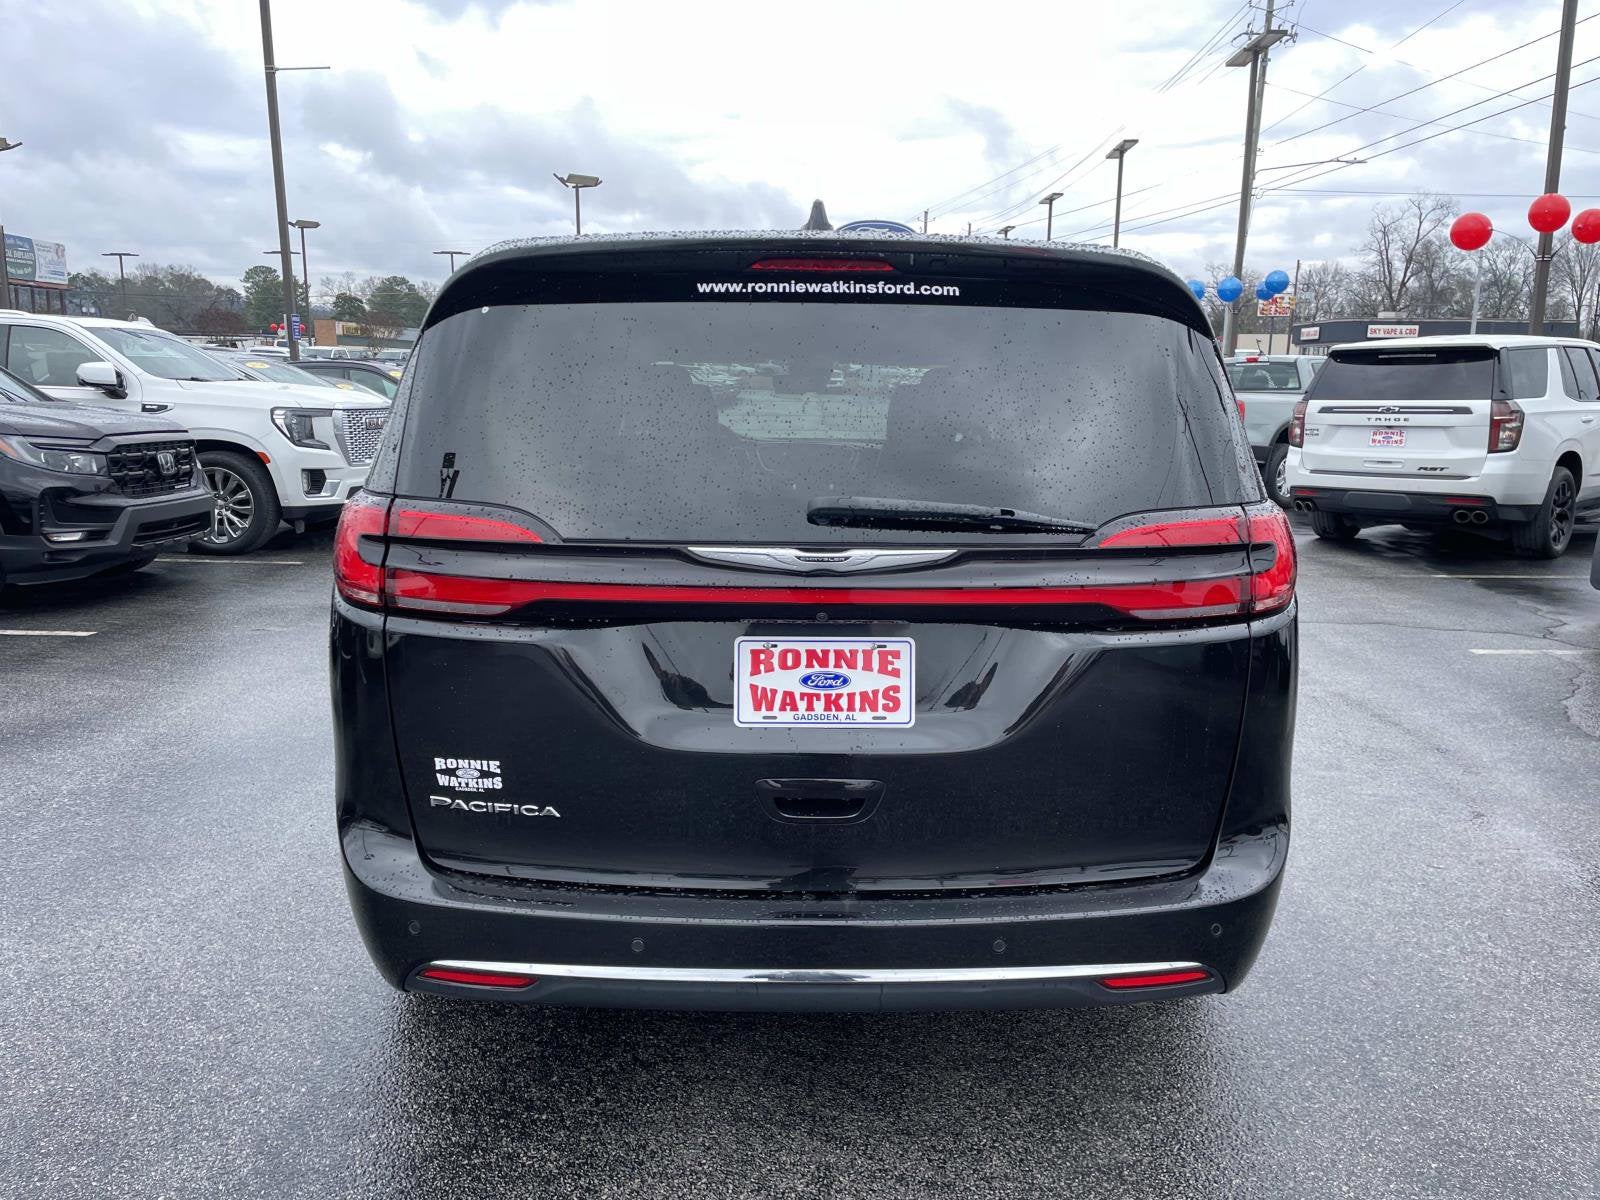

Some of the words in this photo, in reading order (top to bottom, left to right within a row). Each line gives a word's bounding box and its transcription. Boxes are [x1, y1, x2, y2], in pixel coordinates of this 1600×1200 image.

[696, 280, 960, 296] www.ronniewatkinsford.com
[749, 648, 901, 679] RONNIE
[807, 673, 843, 687] Ford
[749, 683, 902, 713] WATKINS
[793, 713, 842, 722] GADSDEN,
[844, 713, 857, 721] AL
[434, 757, 501, 774] RONNIE
[436, 772, 503, 789] WATKINS
[429, 795, 561, 818] PACIFICA
